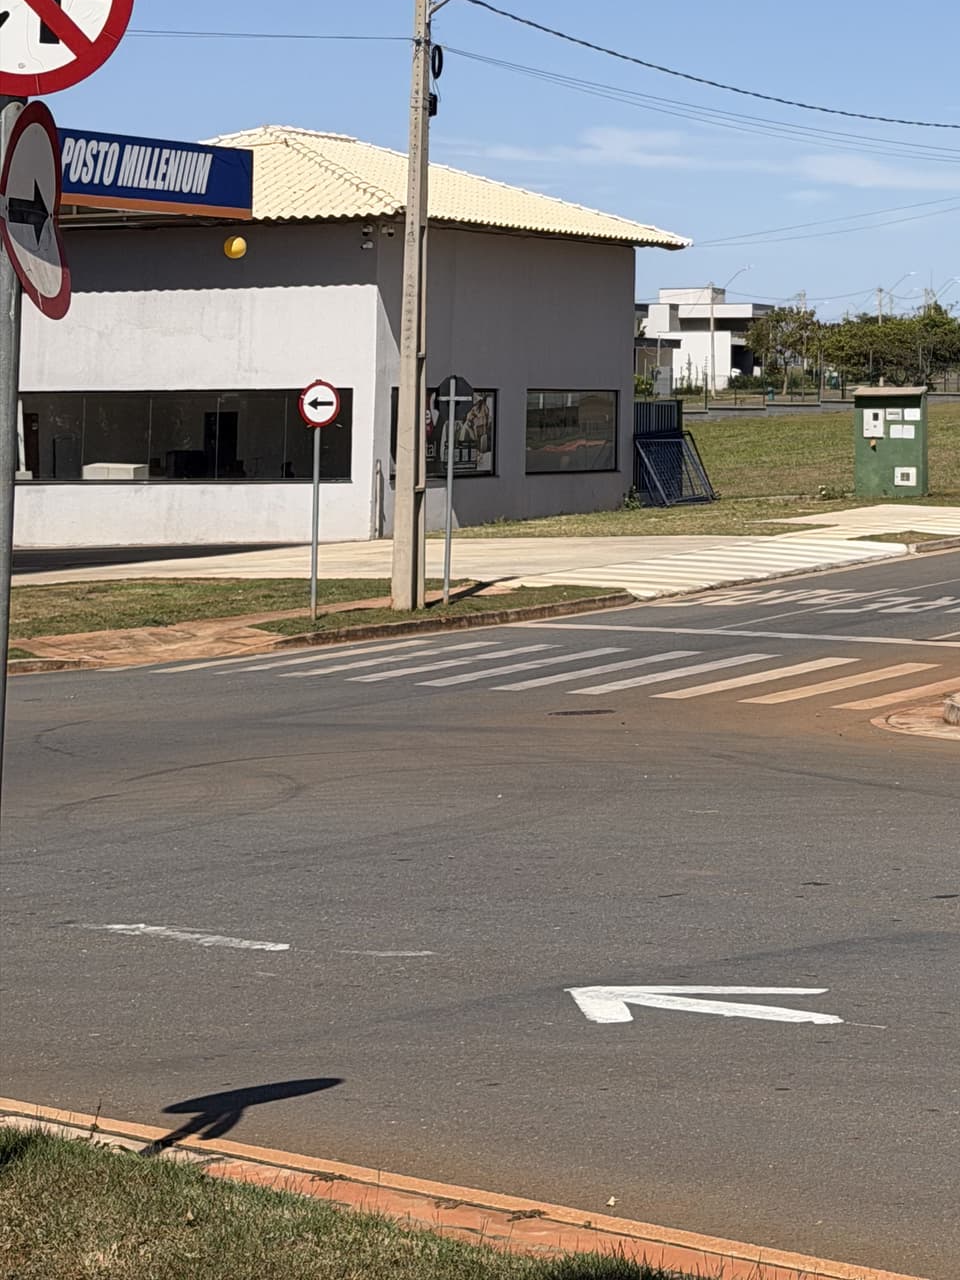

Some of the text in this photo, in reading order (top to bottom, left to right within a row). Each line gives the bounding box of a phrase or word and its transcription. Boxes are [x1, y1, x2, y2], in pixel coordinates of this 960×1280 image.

[61, 137, 213, 195] POSTO MILLENIUM
[650, 588, 900, 607] PARE
